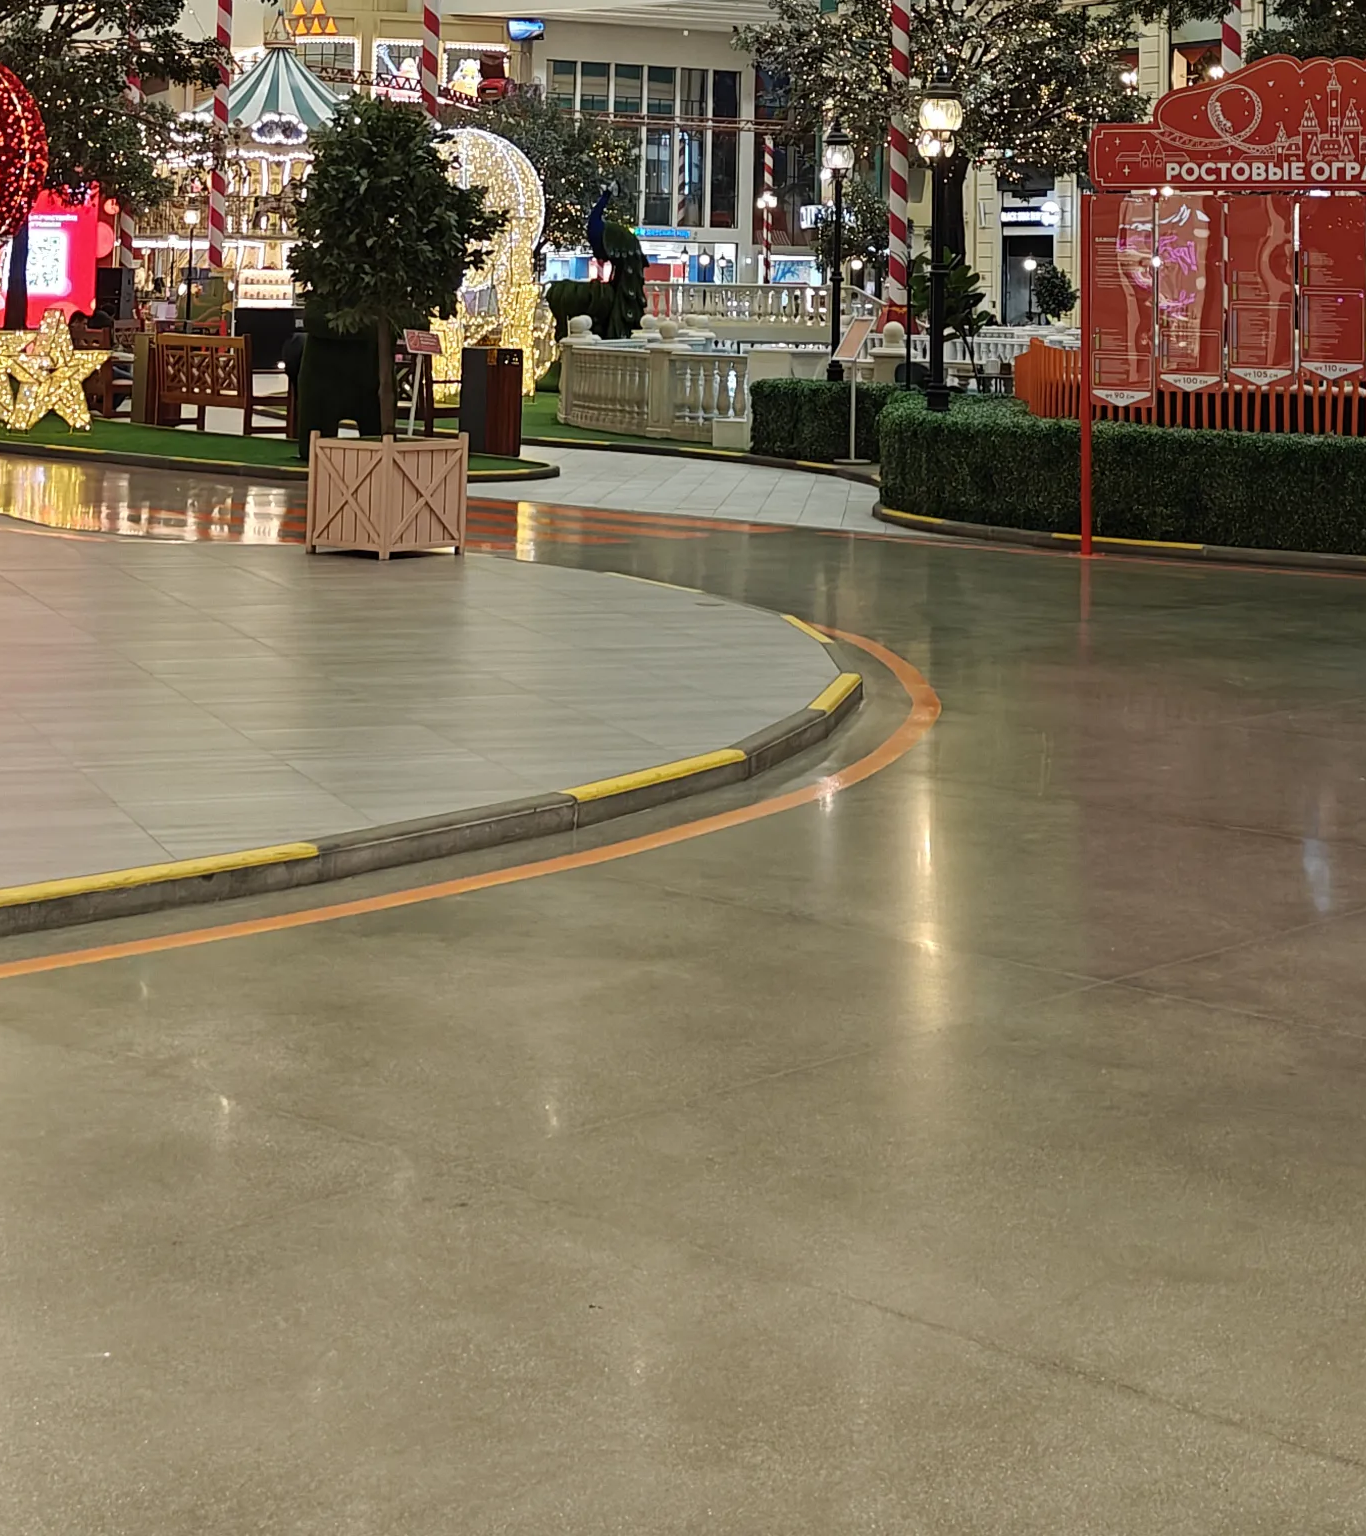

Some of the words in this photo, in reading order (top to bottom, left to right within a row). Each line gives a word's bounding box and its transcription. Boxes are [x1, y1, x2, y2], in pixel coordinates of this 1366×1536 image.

[1166, 161, 1306, 181] РОСТОВЫЕ
[1252, 370, 1268, 378] 105
[1182, 377, 1198, 385] 100
[1114, 391, 1125, 399] 90
